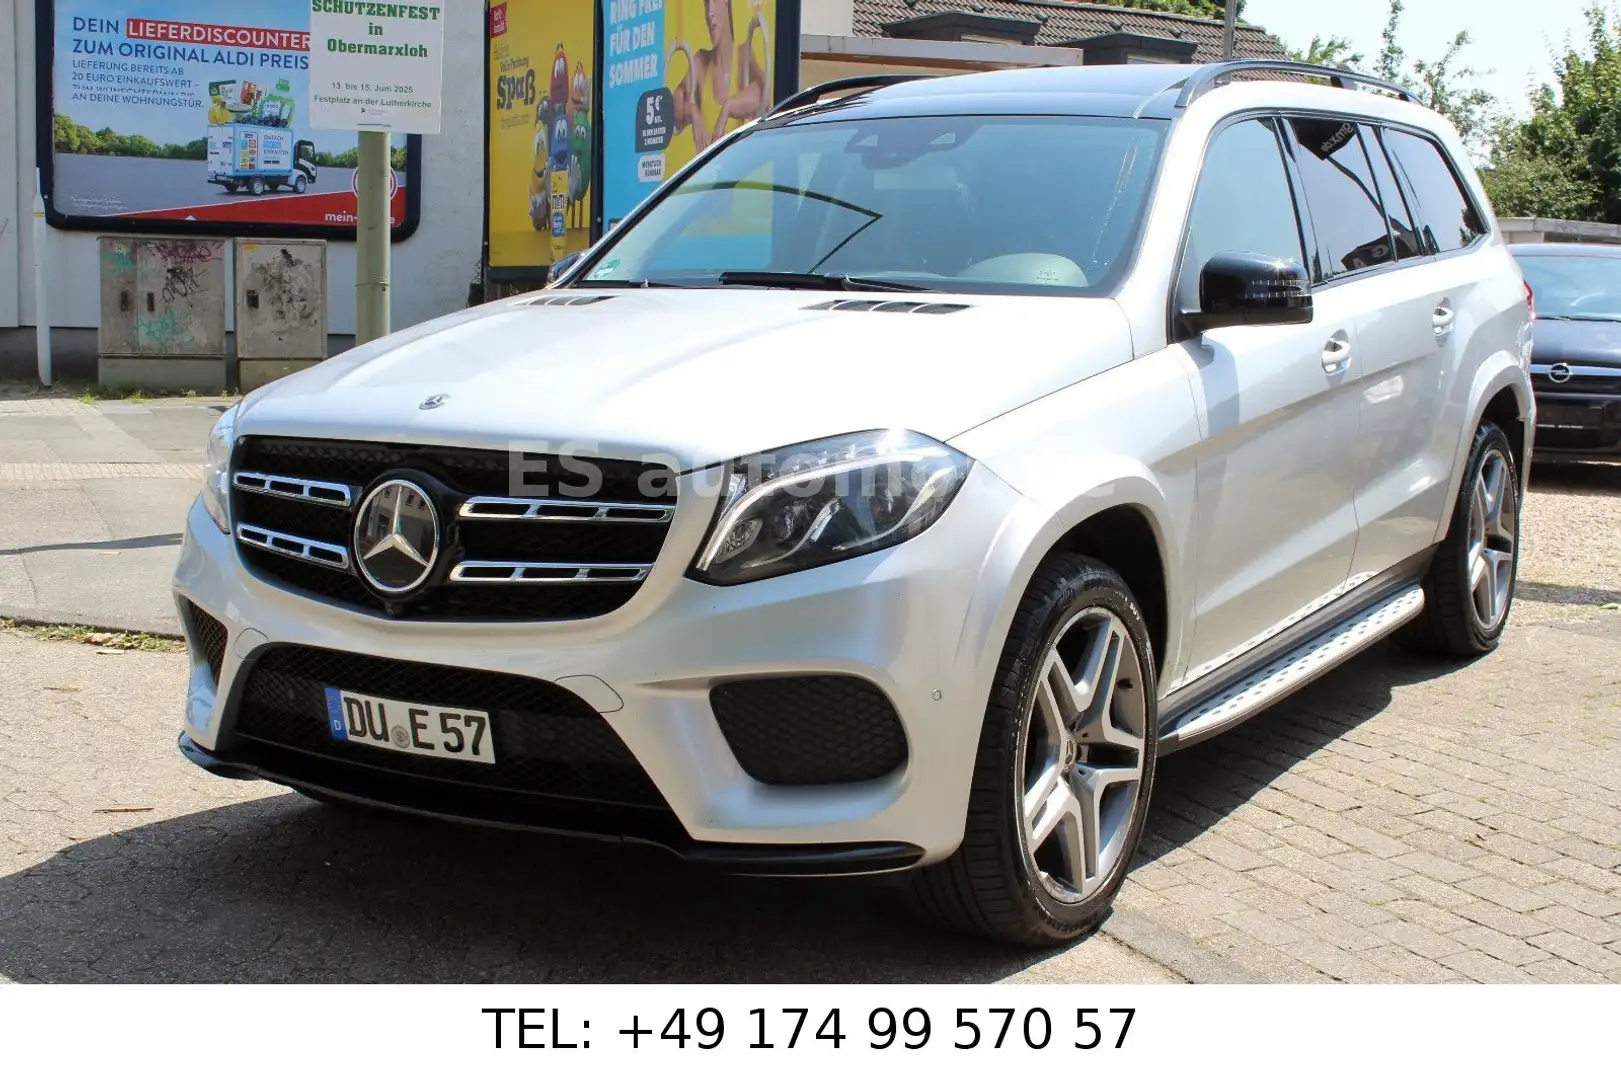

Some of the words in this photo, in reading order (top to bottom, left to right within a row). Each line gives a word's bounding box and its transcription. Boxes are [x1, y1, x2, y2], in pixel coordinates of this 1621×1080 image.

[610, 0, 636, 25] RING
[73, 17, 119, 34] DEIN
[128, 21, 310, 49] LIEFERDISCOUNTER
[368, 22, 383, 35] in
[610, 24, 630, 57] FÜR
[633, 20, 655, 50] DEN
[73, 39, 113, 56] ZUM
[119, 43, 209, 63] ORIGINAL
[213, 50, 253, 67] ALDI
[327, 38, 428, 57] Obermarxloh
[72, 59, 128, 71] LIEFERUNG
[131, 64, 169, 75] BEREITS
[171, 67, 184, 76] AB
[609, 53, 658, 88] SOMMER
[72, 72, 84, 80] 20
[86, 73, 114, 83] EURO
[117, 75, 192, 88] EINKAUFSWERT
[345, 82, 358, 90] bis
[374, 84, 392, 92] Juni
[394, 85, 413, 94] 2025
[496, 69, 535, 110] Spaß
[72, 92, 87, 101] AN
[89, 93, 119, 103] DEINE
[314, 95, 350, 105] Festplatz
[365, 97, 379, 106] der
[381, 98, 432, 108] Lutherkirche
[344, 697, 389, 742] DU
